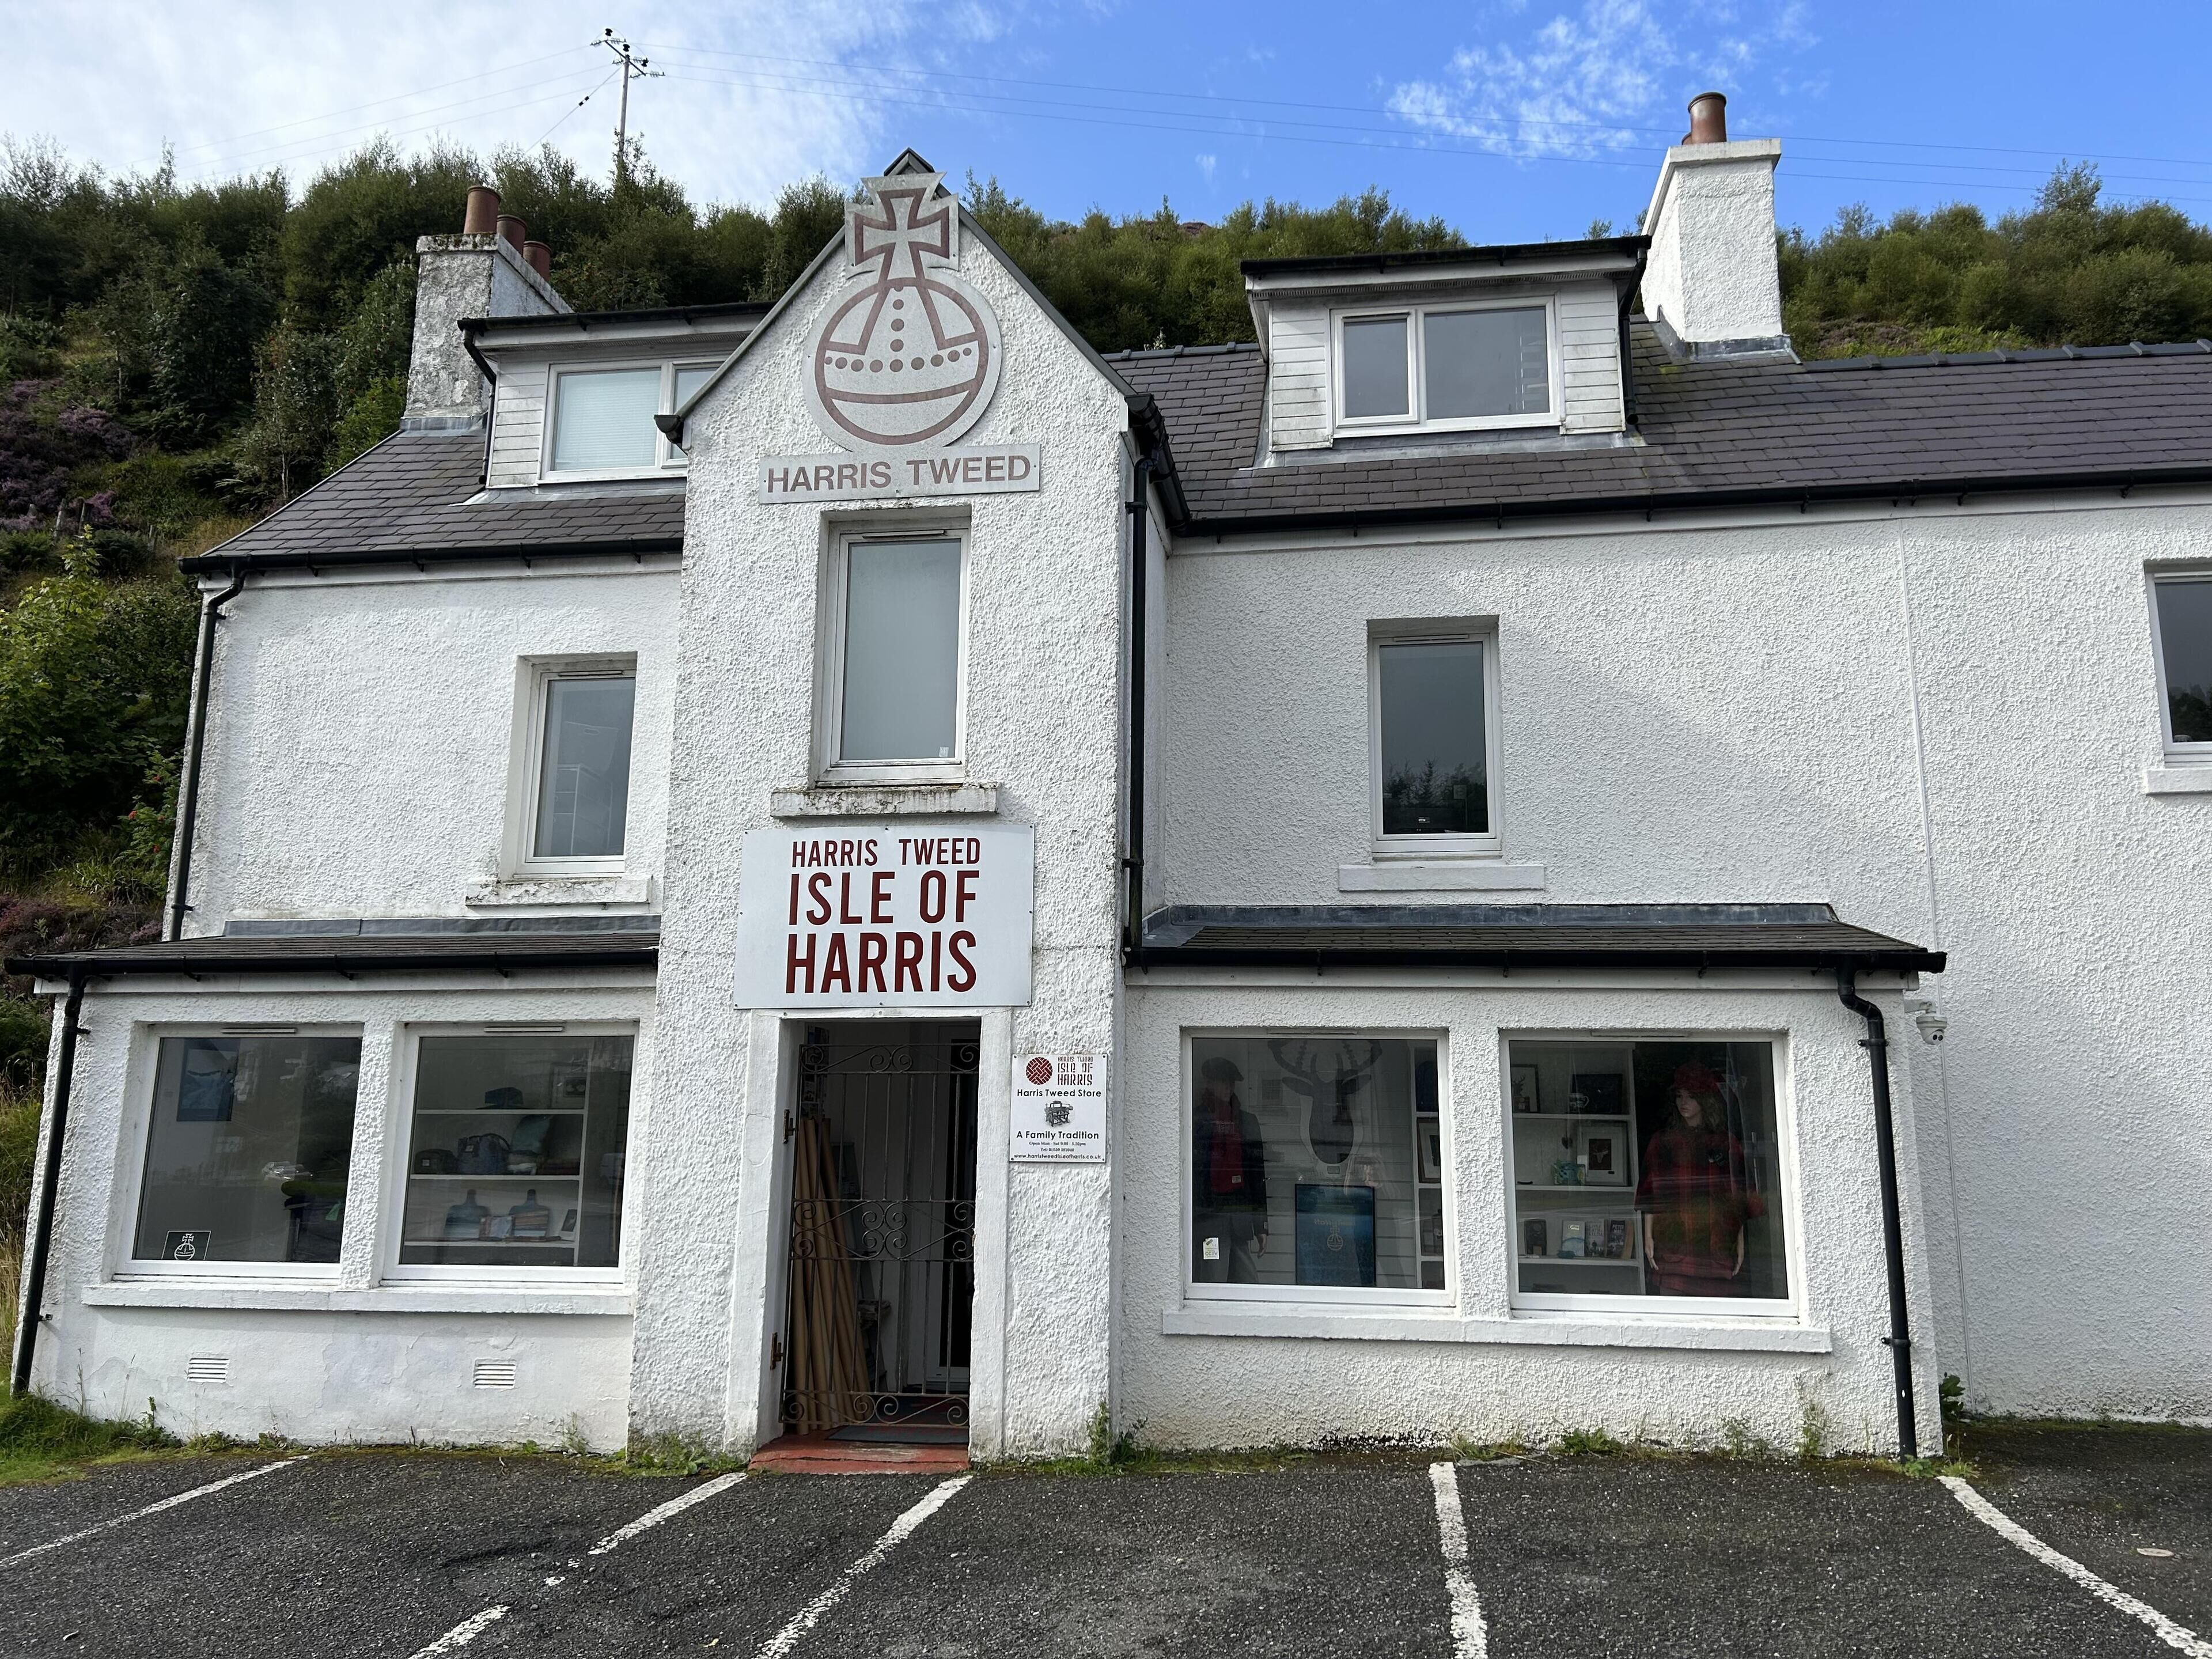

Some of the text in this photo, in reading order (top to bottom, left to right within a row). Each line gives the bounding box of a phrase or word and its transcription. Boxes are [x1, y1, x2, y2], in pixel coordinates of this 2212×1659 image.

[768, 455, 1031, 493] HARRIS TWEED
[792, 838, 980, 867] HARRIS TWEED
[789, 870, 979, 925] ISLE OF
[786, 930, 976, 993] HARRIS
[1057, 1074, 1093, 1085] HARRIS
[1058, 1063, 1093, 1073] ISLE OF
[1026, 1131, 1056, 1140] Family
[1058, 1131, 1099, 1139] Tradition
